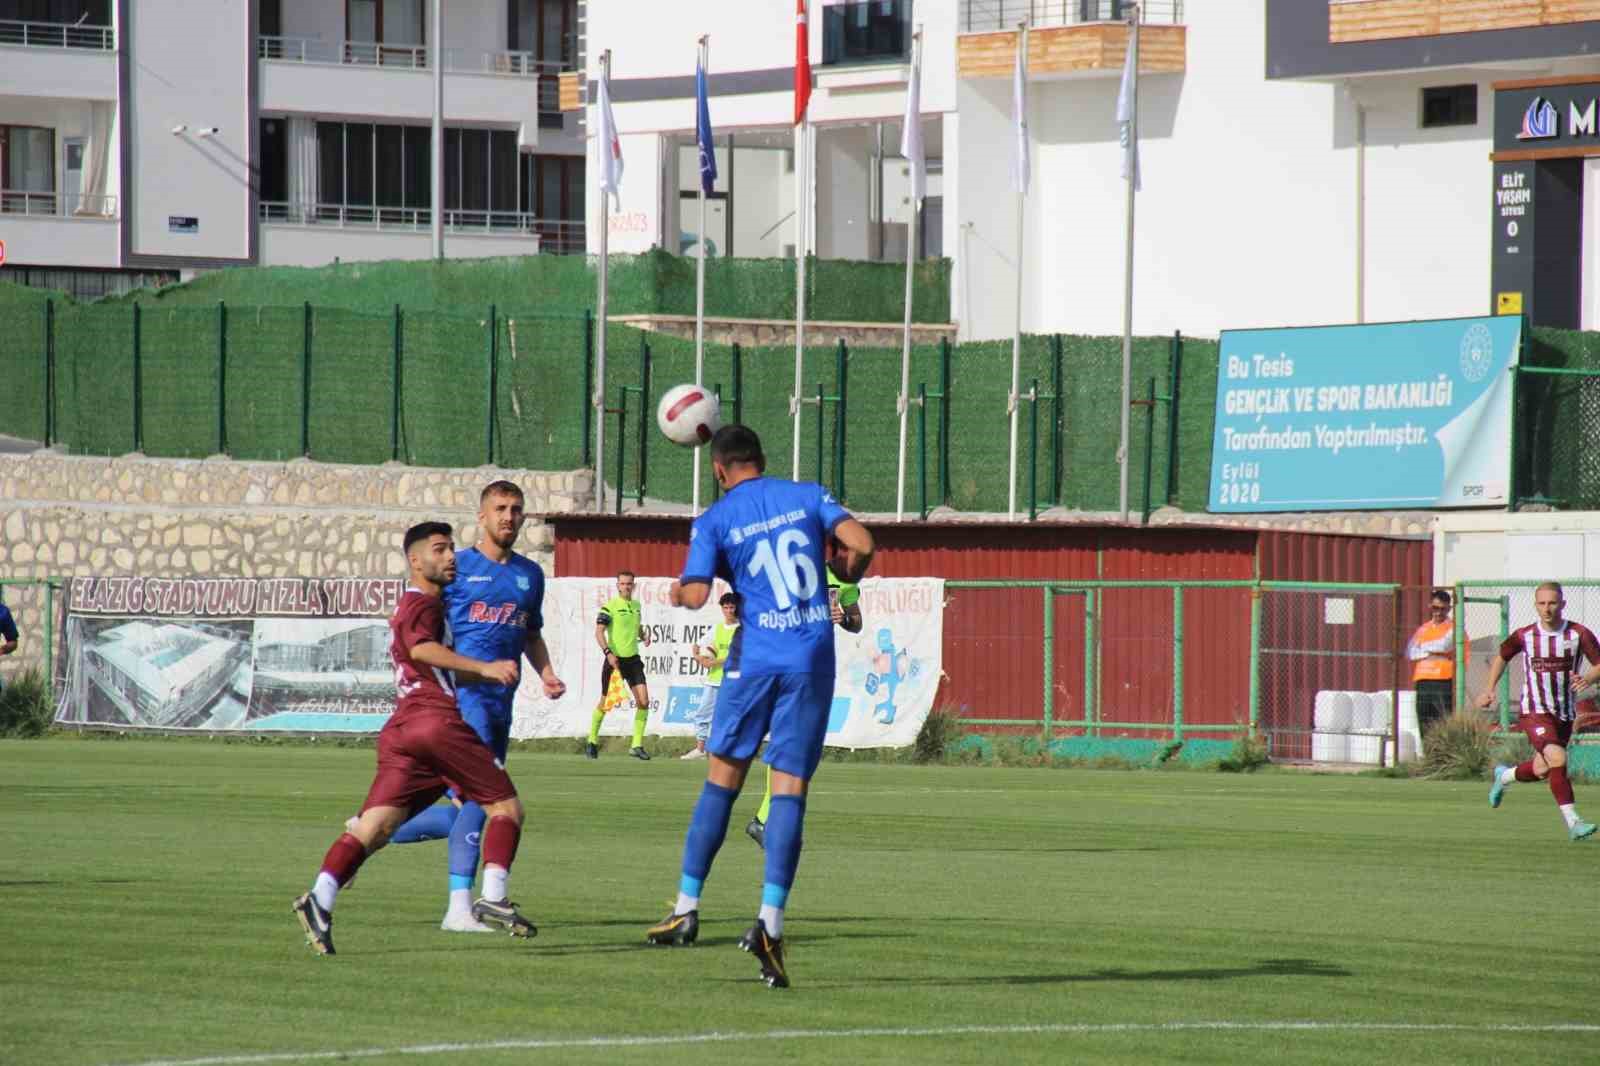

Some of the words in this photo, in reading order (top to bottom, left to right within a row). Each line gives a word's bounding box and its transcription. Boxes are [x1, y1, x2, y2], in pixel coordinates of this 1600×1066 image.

[1228, 356, 1249, 379] Bu
[1225, 386, 1289, 421] GENÇLİK
[1295, 386, 1313, 412] VE
[1317, 384, 1360, 412] SPOR
[1364, 373, 1454, 409] BAKANLIĞI
[1223, 424, 1311, 450] Tarafından
[1222, 463, 1259, 482] Eylül
[1219, 483, 1261, 505] 2020
[747, 528, 819, 610] 16
[143, 578, 257, 615] STADYUMU
[256, 578, 323, 615] HIZLA
[758, 604, 802, 632] RÜŞTÜ
